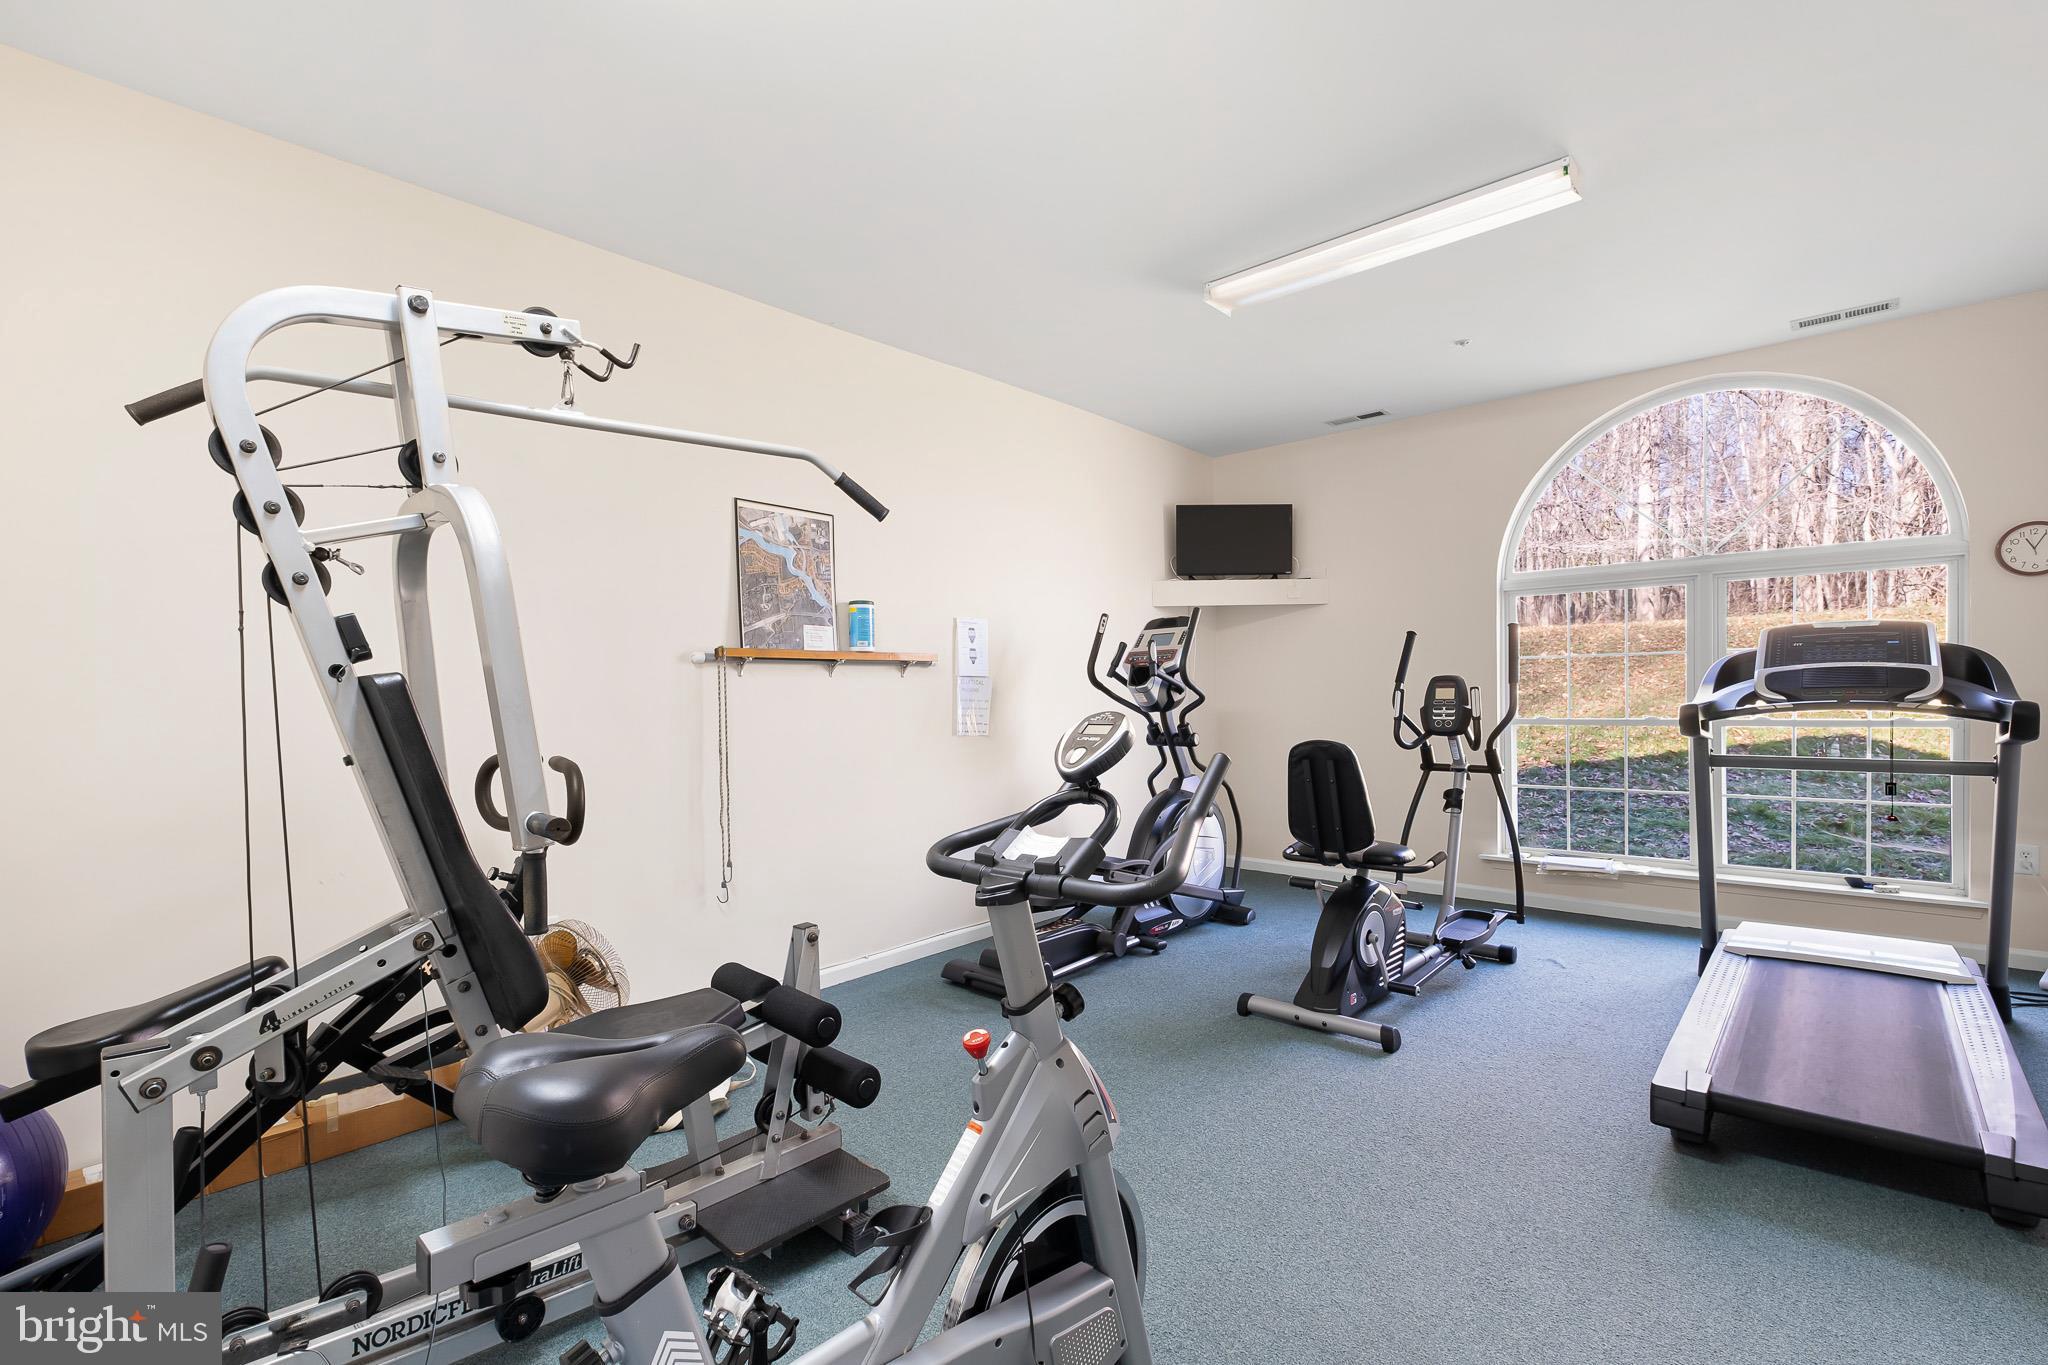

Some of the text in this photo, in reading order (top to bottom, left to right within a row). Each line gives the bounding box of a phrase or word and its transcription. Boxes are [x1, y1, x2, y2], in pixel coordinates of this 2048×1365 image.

[2030, 527, 2039, 535] 12
[259, 1010, 281, 1035] 4
[323, 980, 355, 999] SYSTEM
